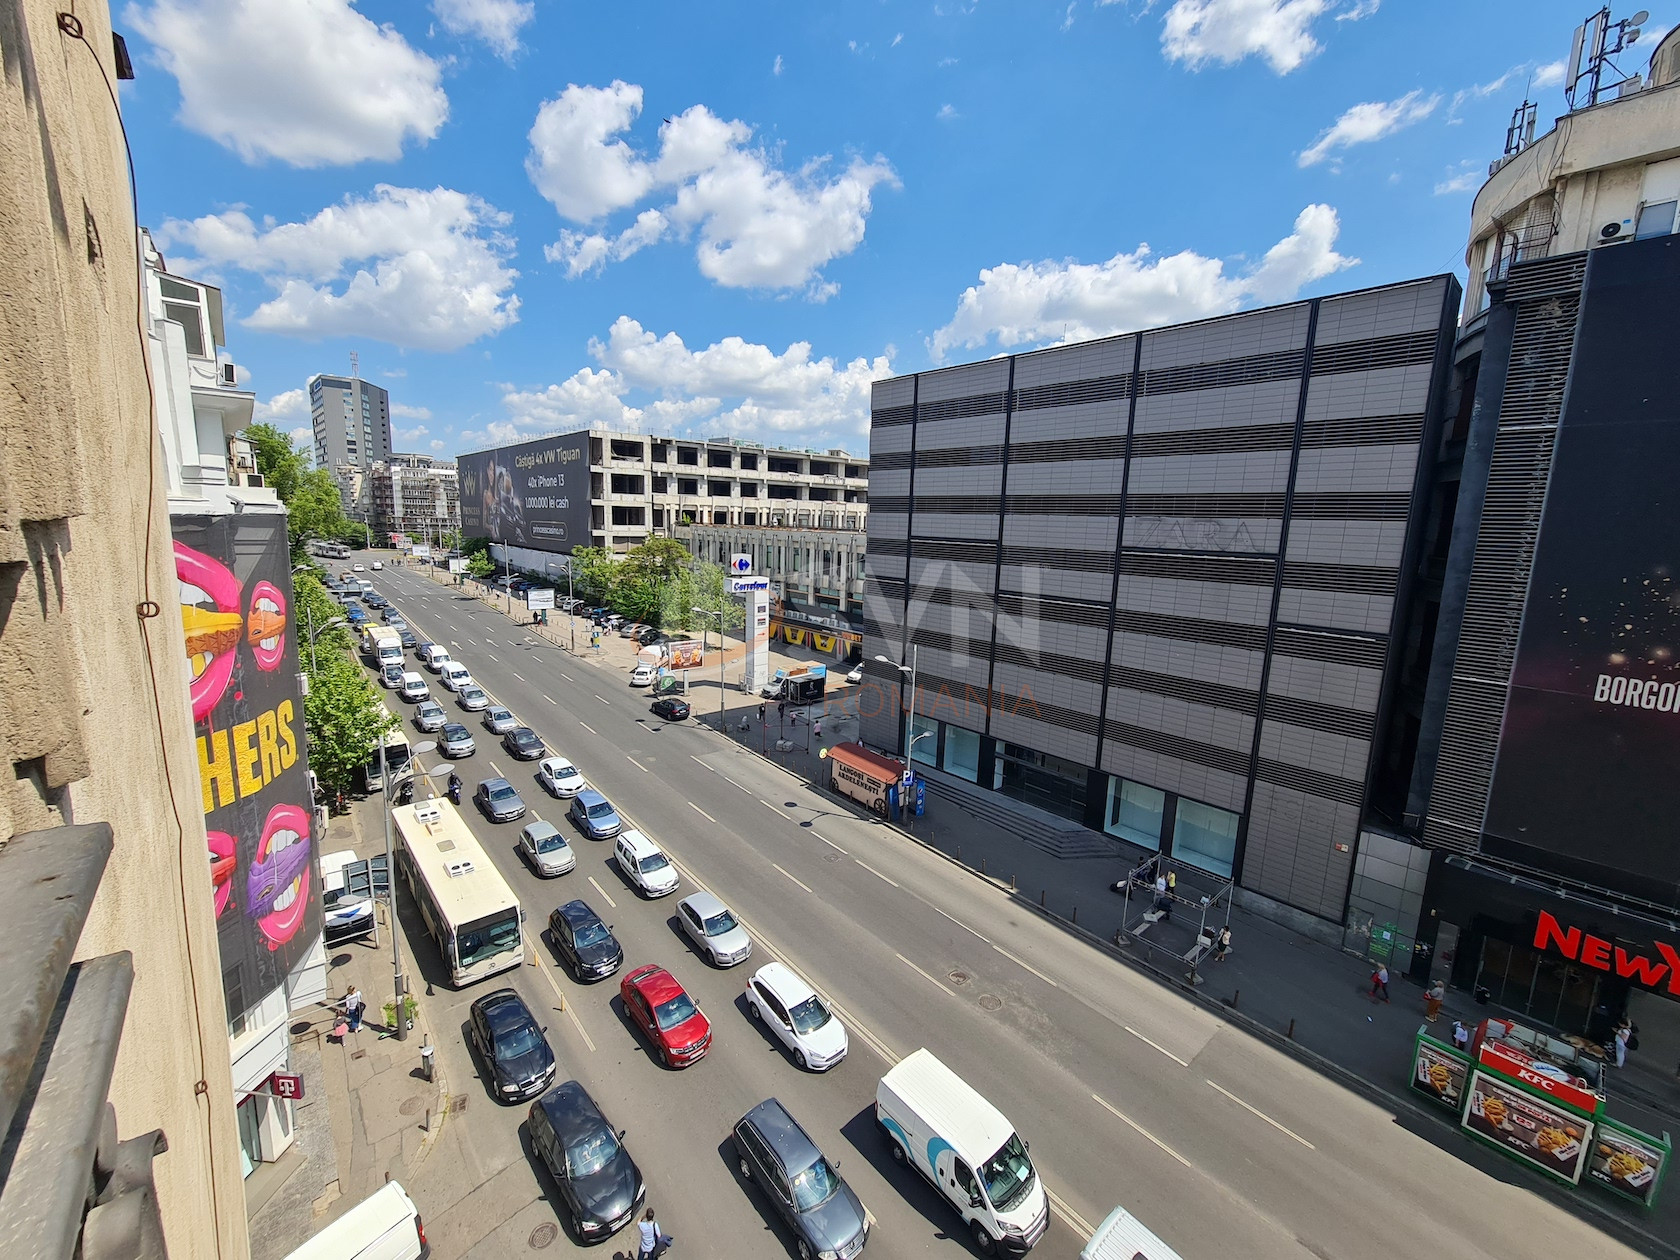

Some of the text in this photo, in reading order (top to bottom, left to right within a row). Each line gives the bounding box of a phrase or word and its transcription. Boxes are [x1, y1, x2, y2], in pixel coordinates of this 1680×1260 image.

[536, 452, 543, 465] 4x
[544, 449, 555, 464] VW
[556, 447, 580, 464] Tiguan
[528, 474, 565, 488] 40x iPhone 13
[556, 496, 570, 509] cash
[733, 581, 769, 591] Carrefour
[1518, 1069, 1555, 1090] KFC
[1507, 1135, 1530, 1150] KFC
